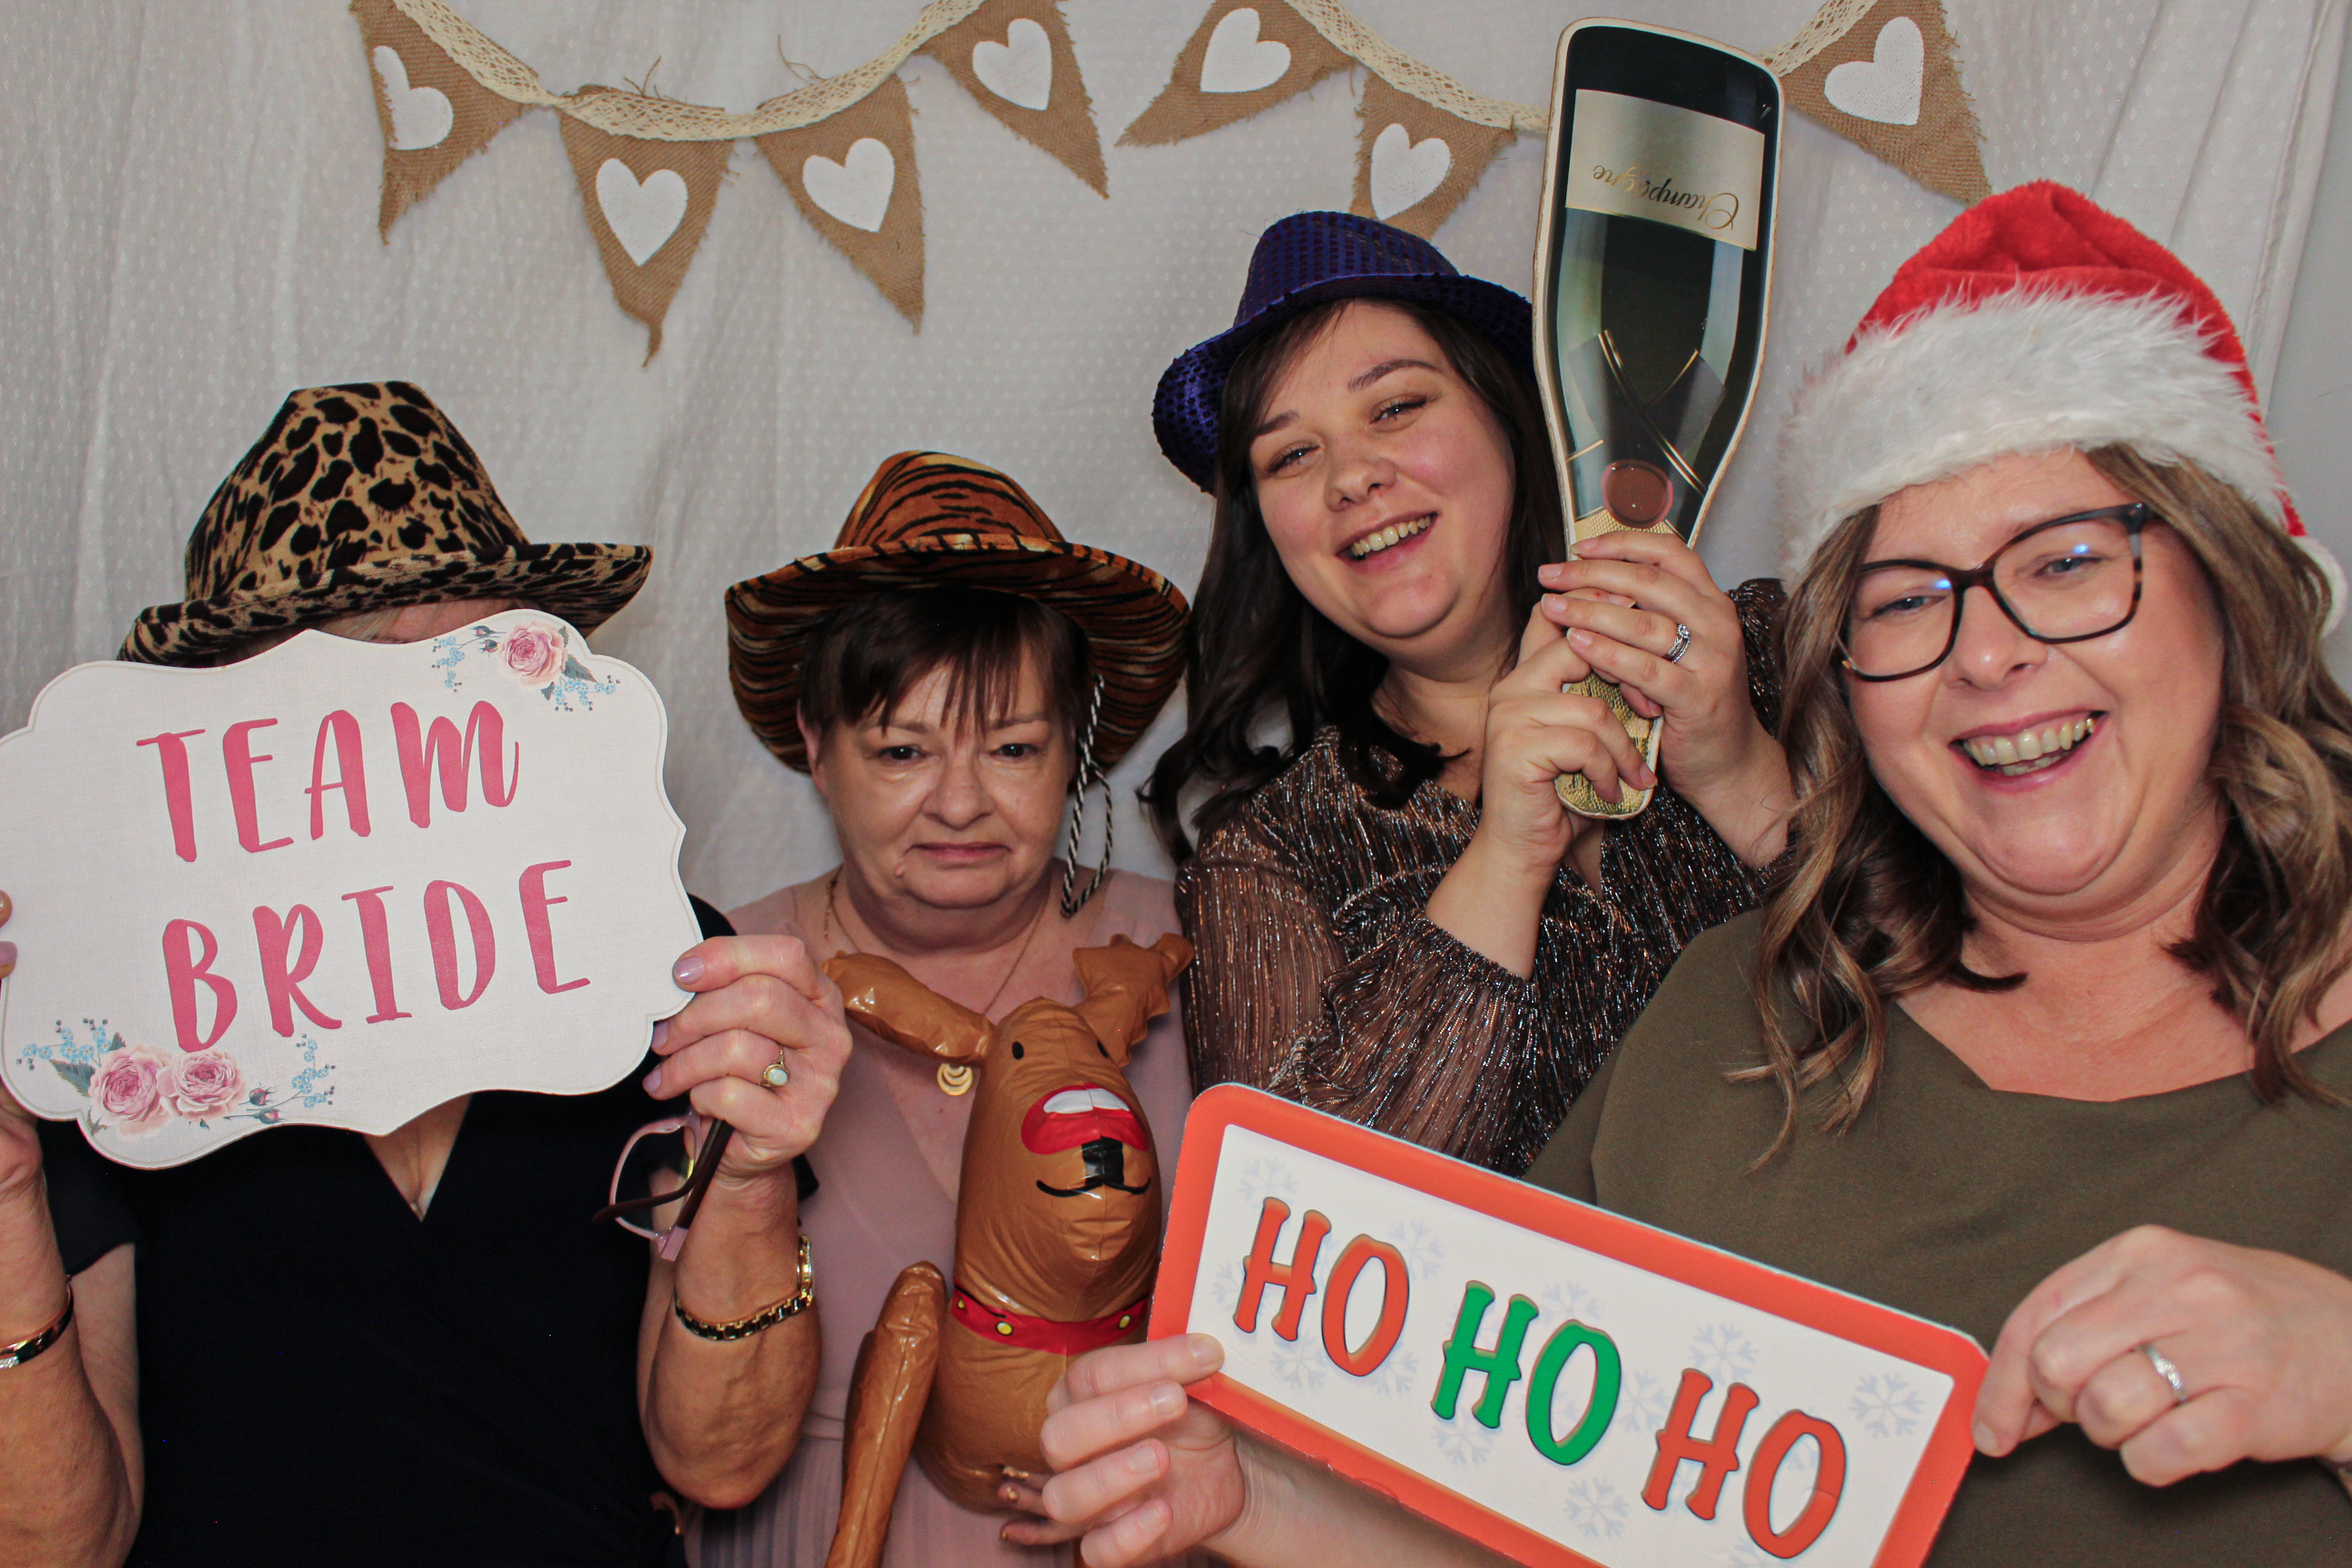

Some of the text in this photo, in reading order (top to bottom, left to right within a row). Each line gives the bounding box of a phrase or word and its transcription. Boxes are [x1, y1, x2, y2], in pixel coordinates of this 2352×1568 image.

[1592, 164, 1740, 230] Champagne
[136, 701, 519, 862] TEAM
[162, 859, 591, 1054] BRIDE
[1232, 1196, 1847, 1560] HO HO HO
